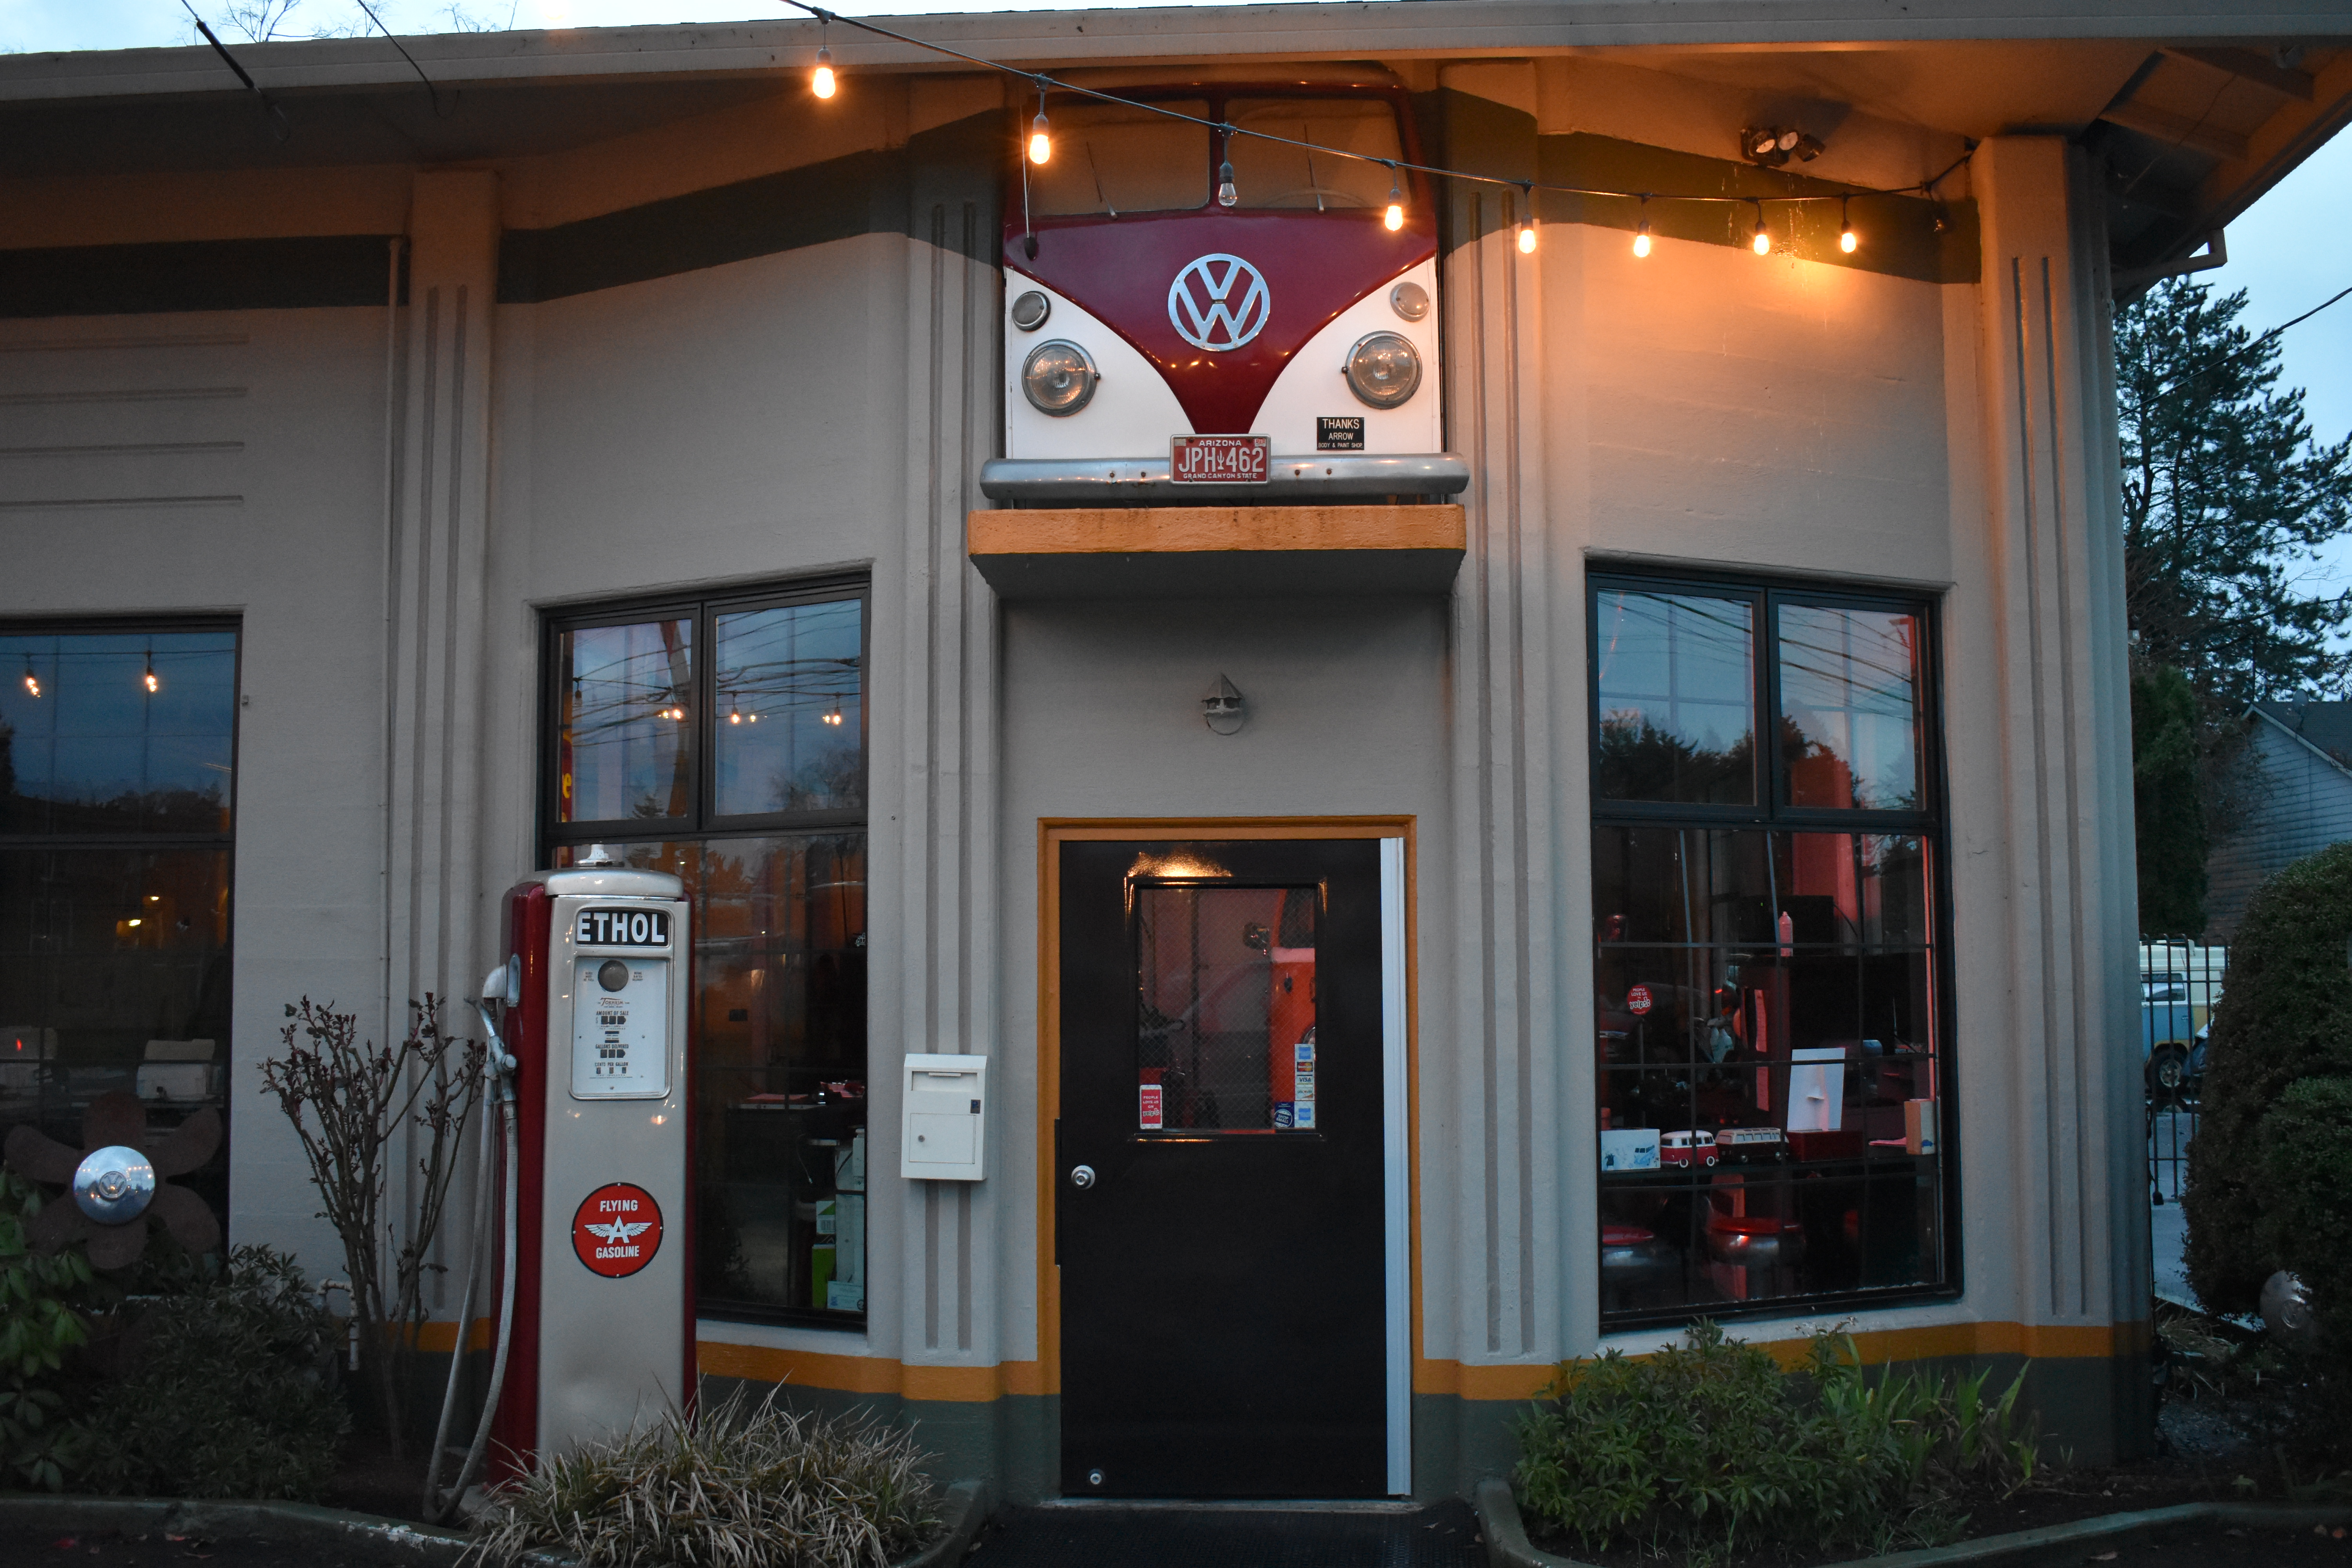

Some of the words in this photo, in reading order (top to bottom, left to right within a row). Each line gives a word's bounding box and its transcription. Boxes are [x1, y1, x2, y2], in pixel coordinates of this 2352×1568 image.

[1168, 253, 1270, 352] VW
[1322, 418, 1359, 429] THANKS
[1178, 447, 1216, 473] JPH
[1226, 447, 1264, 473] 462
[577, 912, 665, 943] ETHOL
[1630, 1000, 1644, 1009] yelp
[600, 1200, 638, 1212] FLYING
[596, 1245, 639, 1259] GASOLINE
